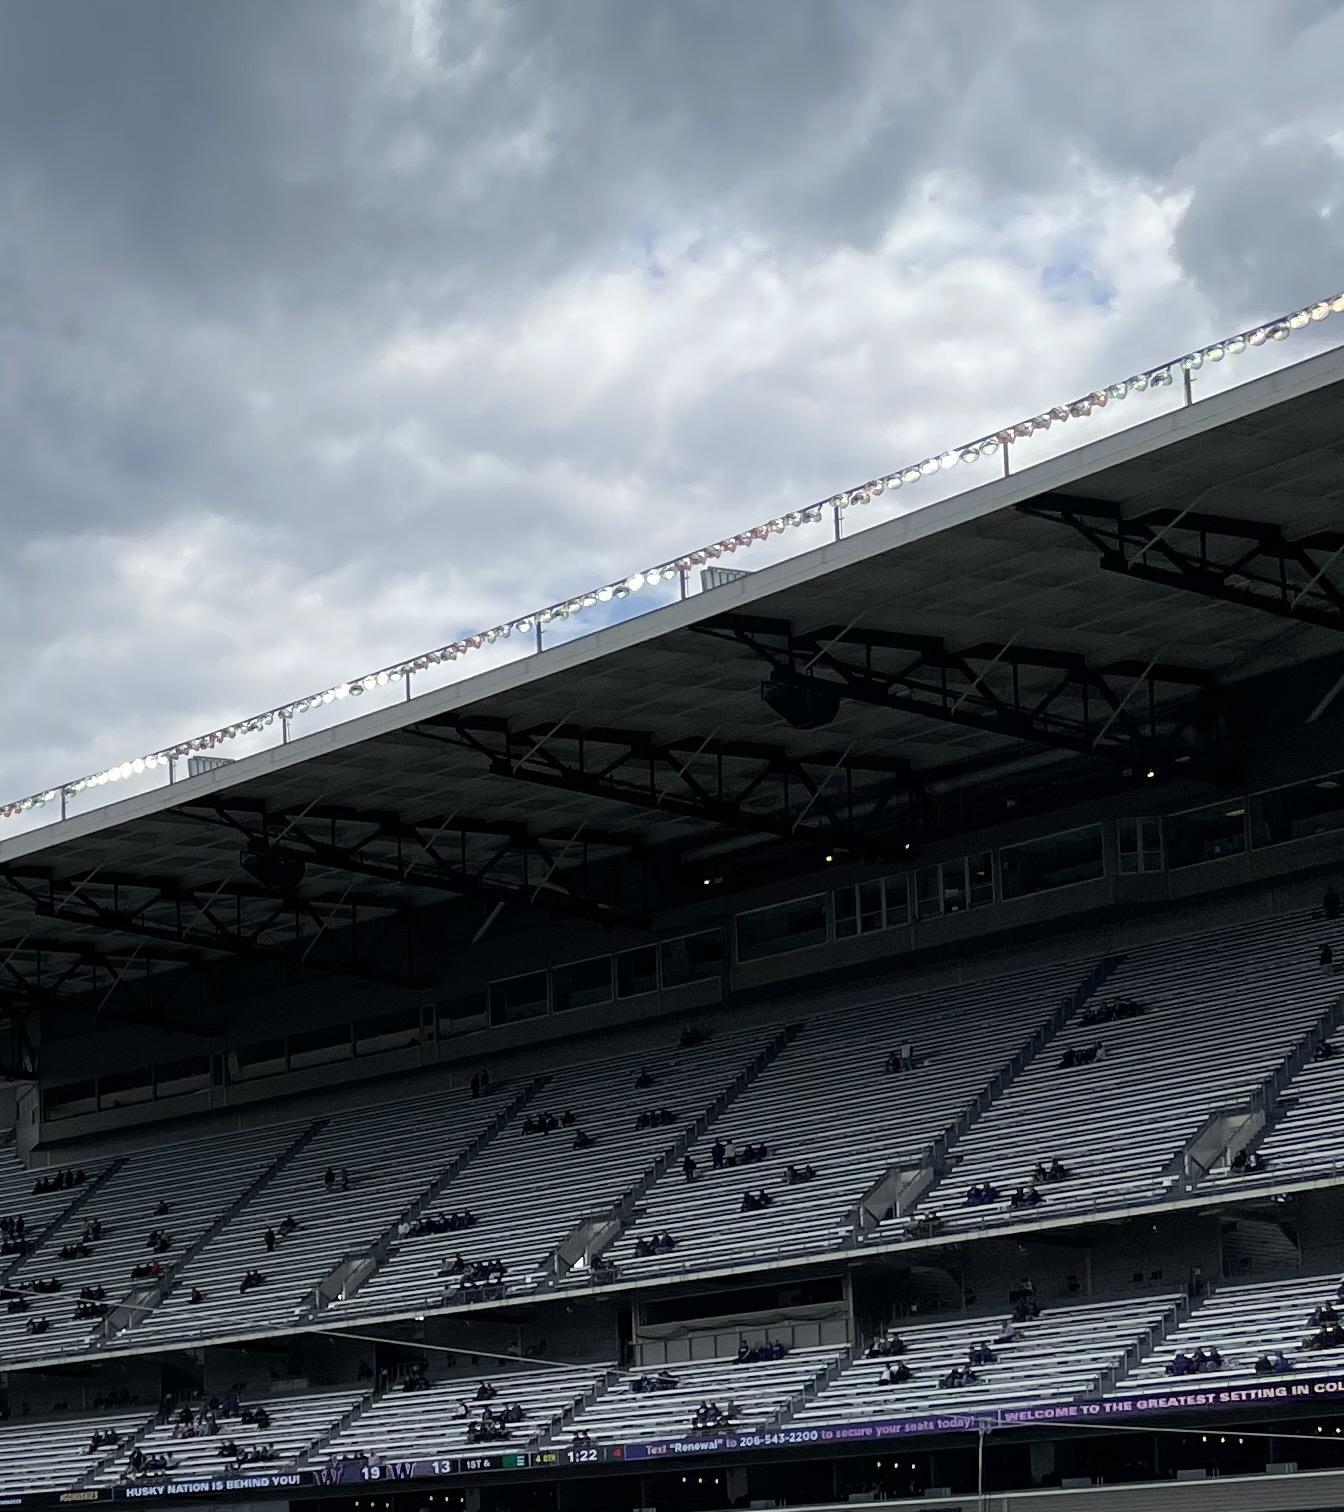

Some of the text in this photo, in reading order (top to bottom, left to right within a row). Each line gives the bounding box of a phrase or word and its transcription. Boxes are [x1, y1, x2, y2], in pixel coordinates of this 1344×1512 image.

[1006, 1384, 1310, 1422] WELCOME TO THE GREATEST SETTING IN
[726, 1439, 737, 1448] to
[740, 1430, 818, 1447] 206-543-2200
[821, 1430, 833, 1440] to
[836, 1426, 873, 1438] secure
[876, 1422, 901, 1437] your
[567, 1450, 597, 1462] 1:22
[362, 1466, 380, 1480] 19
[432, 1460, 451, 1474] 13
[126, 1475, 301, 1498] HUSKY NATION IS BEHIND YOU!
